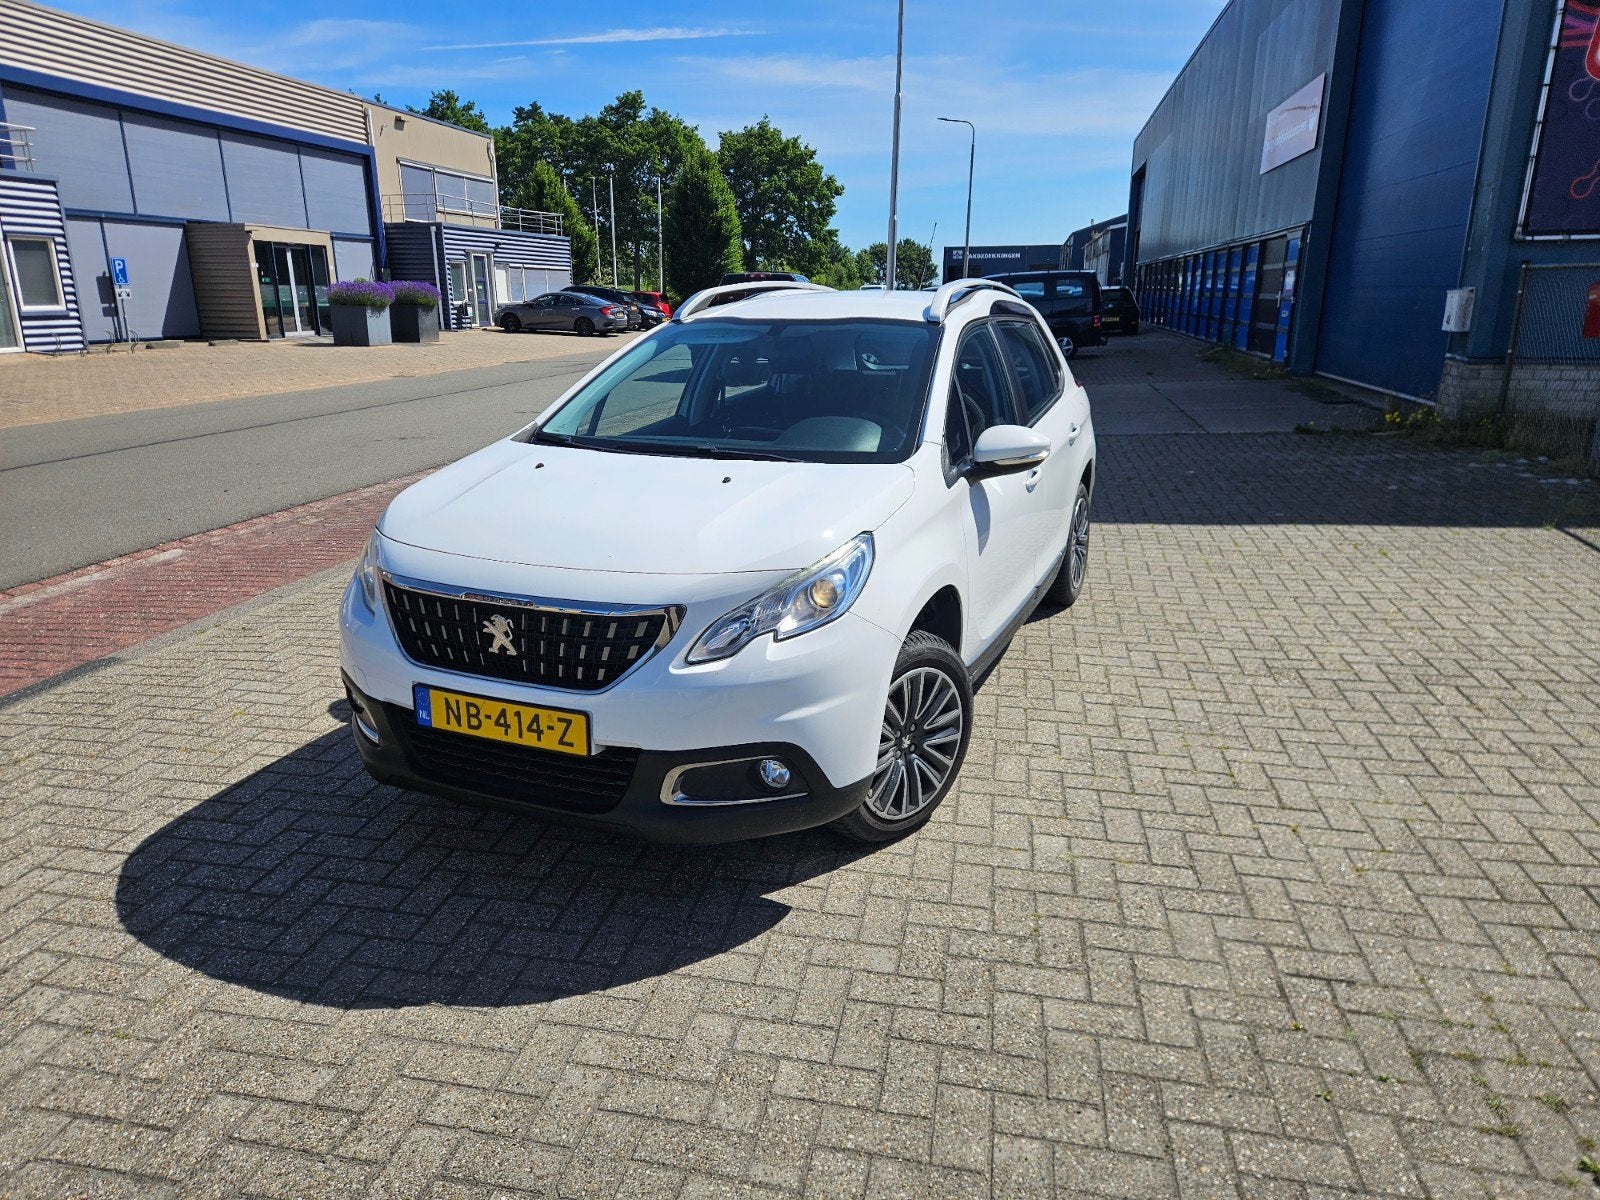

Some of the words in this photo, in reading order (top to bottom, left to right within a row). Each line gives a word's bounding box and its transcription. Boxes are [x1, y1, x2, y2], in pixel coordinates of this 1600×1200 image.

[114, 260, 123, 274] P
[419, 709, 430, 720] NL
[444, 697, 574, 748] NB-414-Z
